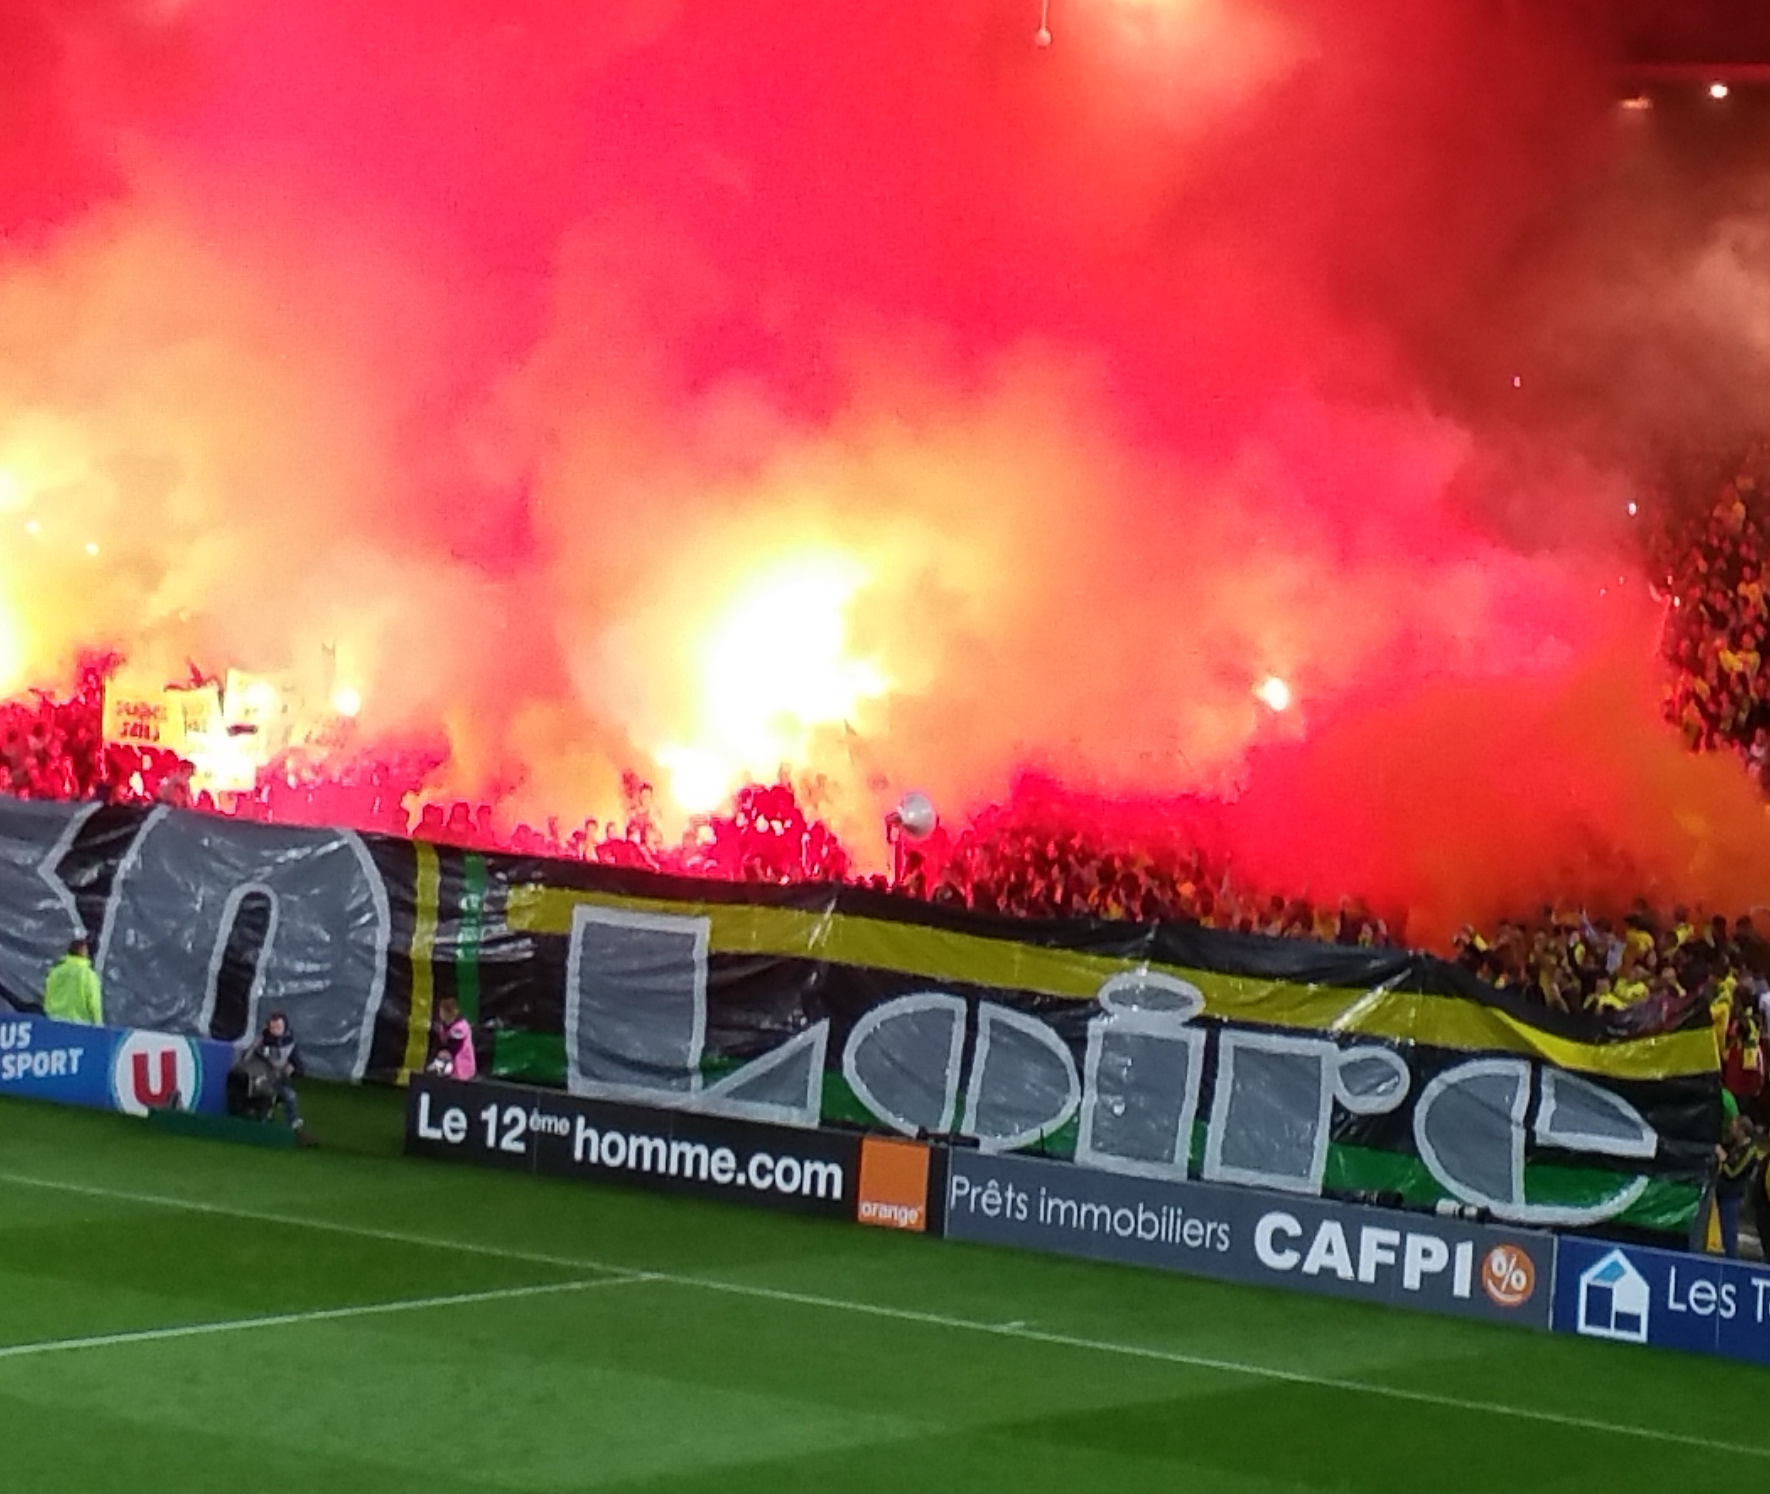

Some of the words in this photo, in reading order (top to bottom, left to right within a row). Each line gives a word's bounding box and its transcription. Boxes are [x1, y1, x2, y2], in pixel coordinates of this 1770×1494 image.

[0, 1048, 84, 1081] SPORT
[566, 903, 1657, 1228] Loire
[418, 1093, 468, 1144] Le
[574, 1115, 843, 1200] homme.com
[860, 1201, 919, 1228] orange
[950, 1174, 1029, 1222] Prêts
[1039, 1187, 1229, 1252] immobiliers
[1254, 1211, 1473, 1299] CAFPI
[1668, 1265, 1737, 1319] Les
